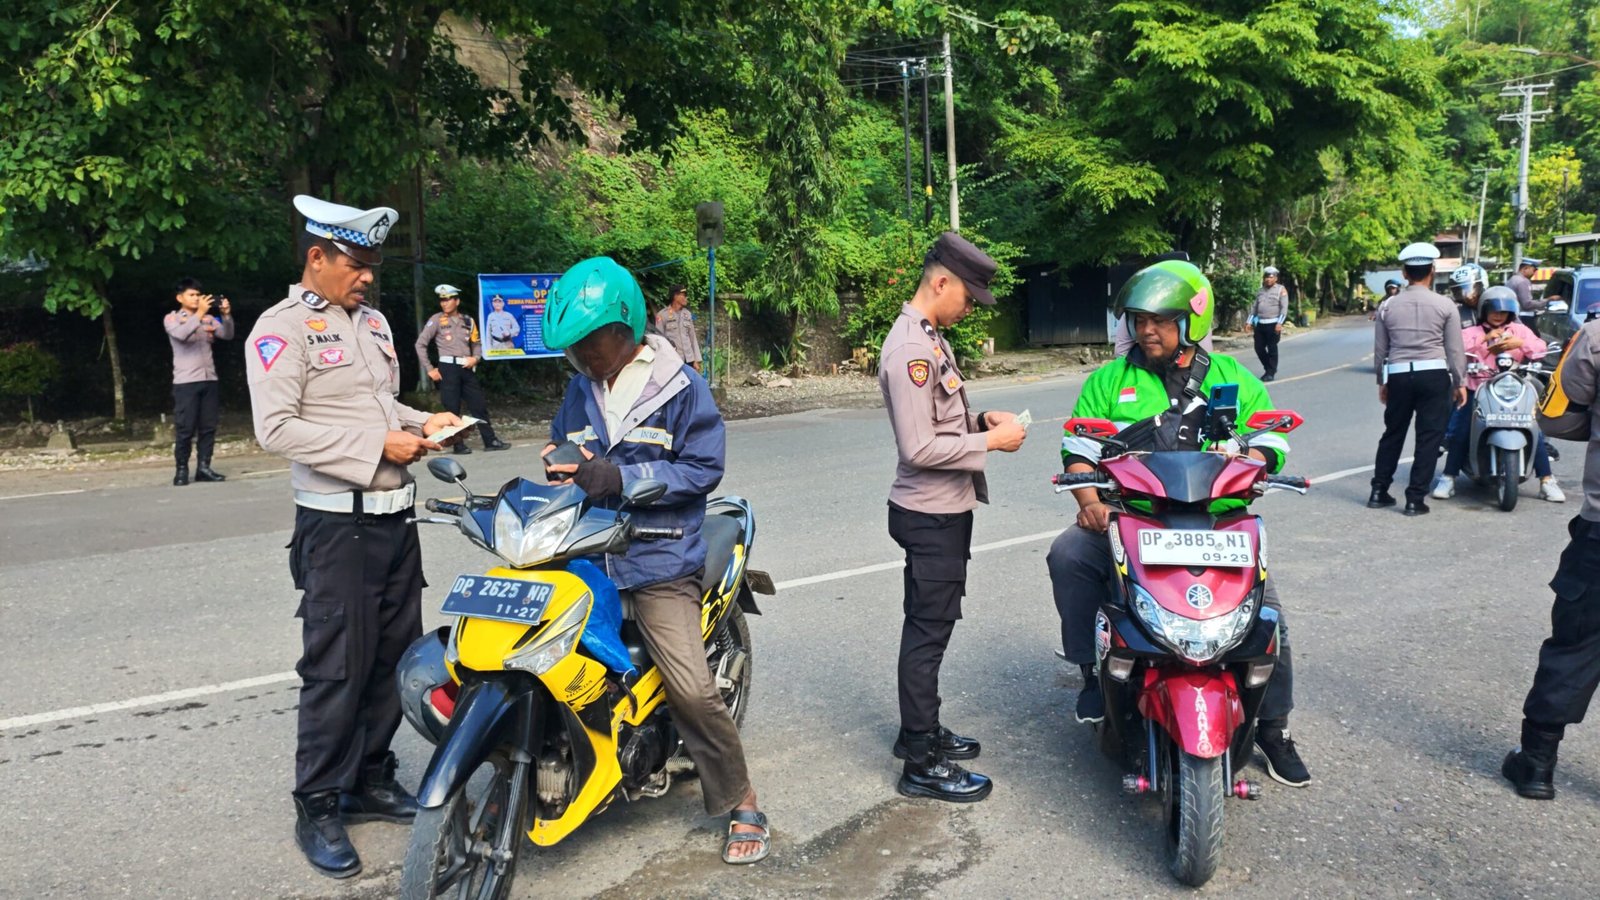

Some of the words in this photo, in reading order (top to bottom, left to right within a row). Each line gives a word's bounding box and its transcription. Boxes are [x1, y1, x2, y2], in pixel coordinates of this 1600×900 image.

[307, 335, 314, 345] S
[317, 333, 342, 344] MALIK
[521, 496, 550, 504] HONDA
[1141, 531, 1162, 546] DP
[1173, 532, 1216, 547] 3885
[1226, 534, 1246, 548] NI
[452, 577, 475, 595] DP
[479, 579, 522, 599] 2625
[526, 584, 550, 602] NR
[1193, 687, 1209, 742] YAMAHA
